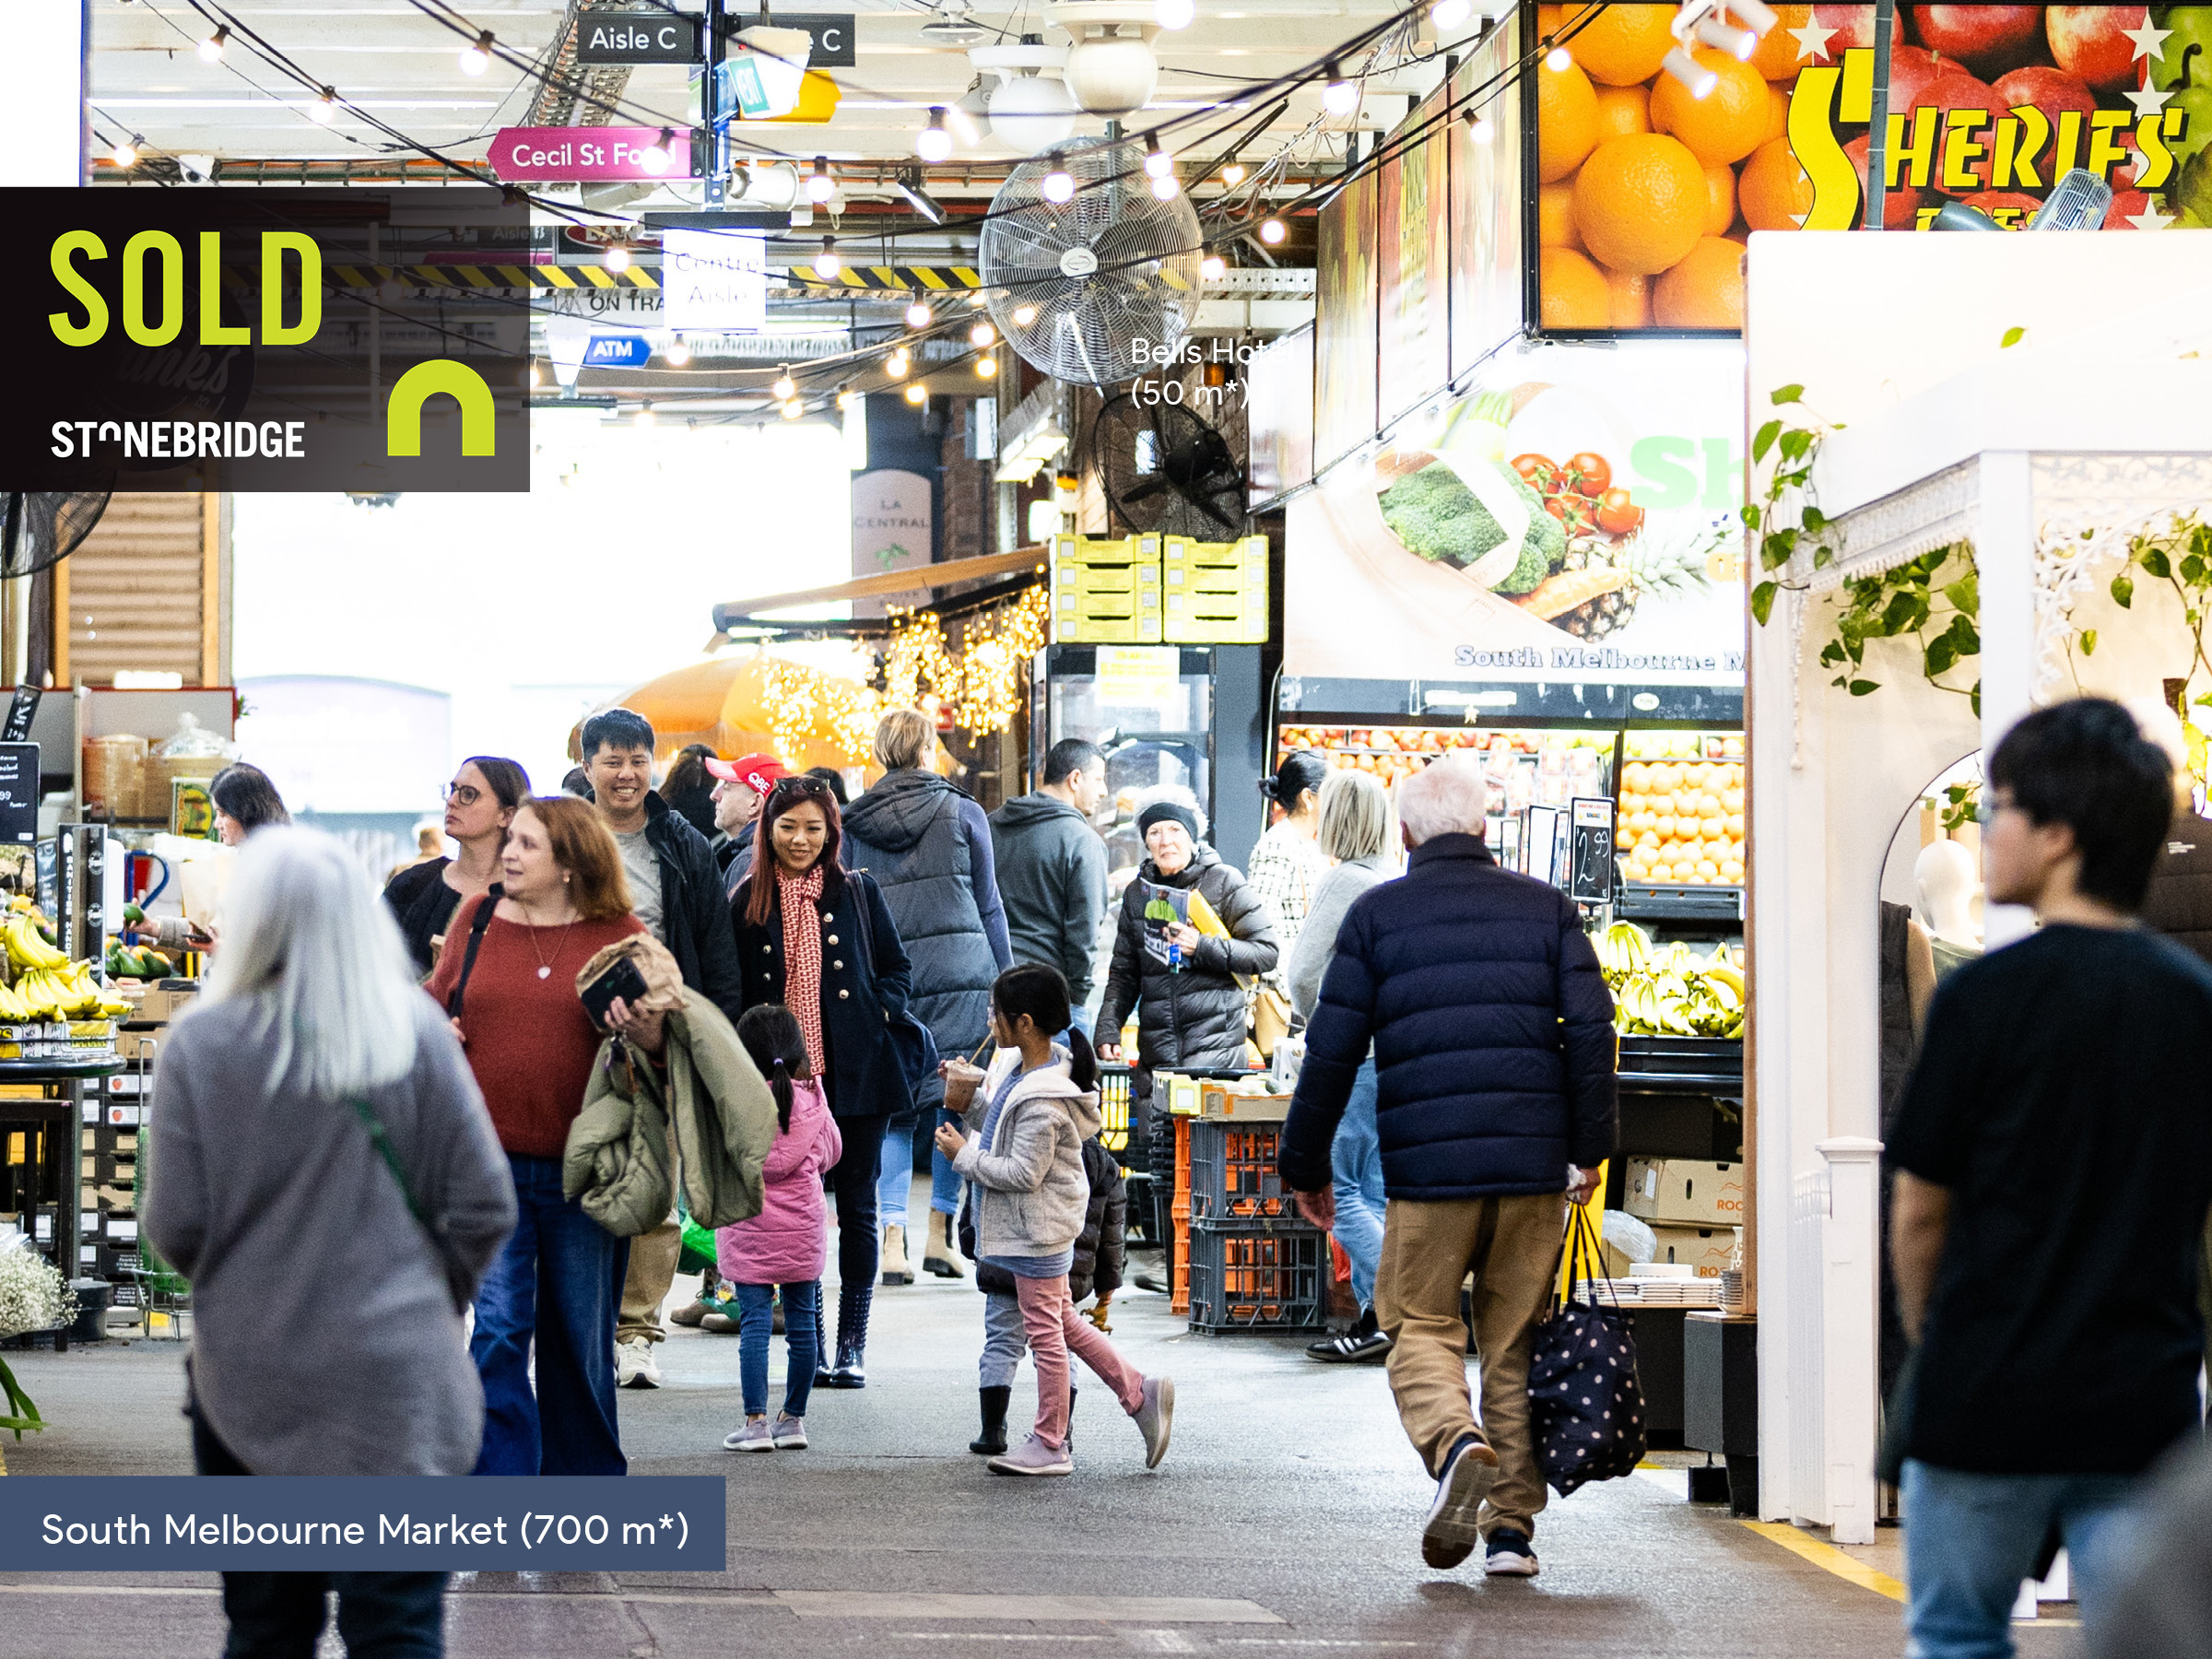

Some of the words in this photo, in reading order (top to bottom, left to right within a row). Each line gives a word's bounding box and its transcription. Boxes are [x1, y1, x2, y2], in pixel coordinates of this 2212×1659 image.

[589, 26, 650, 50] Aisle
[657, 27, 677, 50] C
[822, 29, 841, 52] C
[512, 143, 572, 167] Cecil
[580, 143, 606, 166] St
[613, 141, 677, 165] Fod
[676, 253, 759, 274] Centre
[590, 297, 620, 312] ON
[688, 285, 747, 304] Aisle
[593, 341, 633, 358] ATM
[1455, 645, 1544, 668] South
[1550, 647, 1716, 671] Melbourne
[747, 771, 771, 794] QBE
